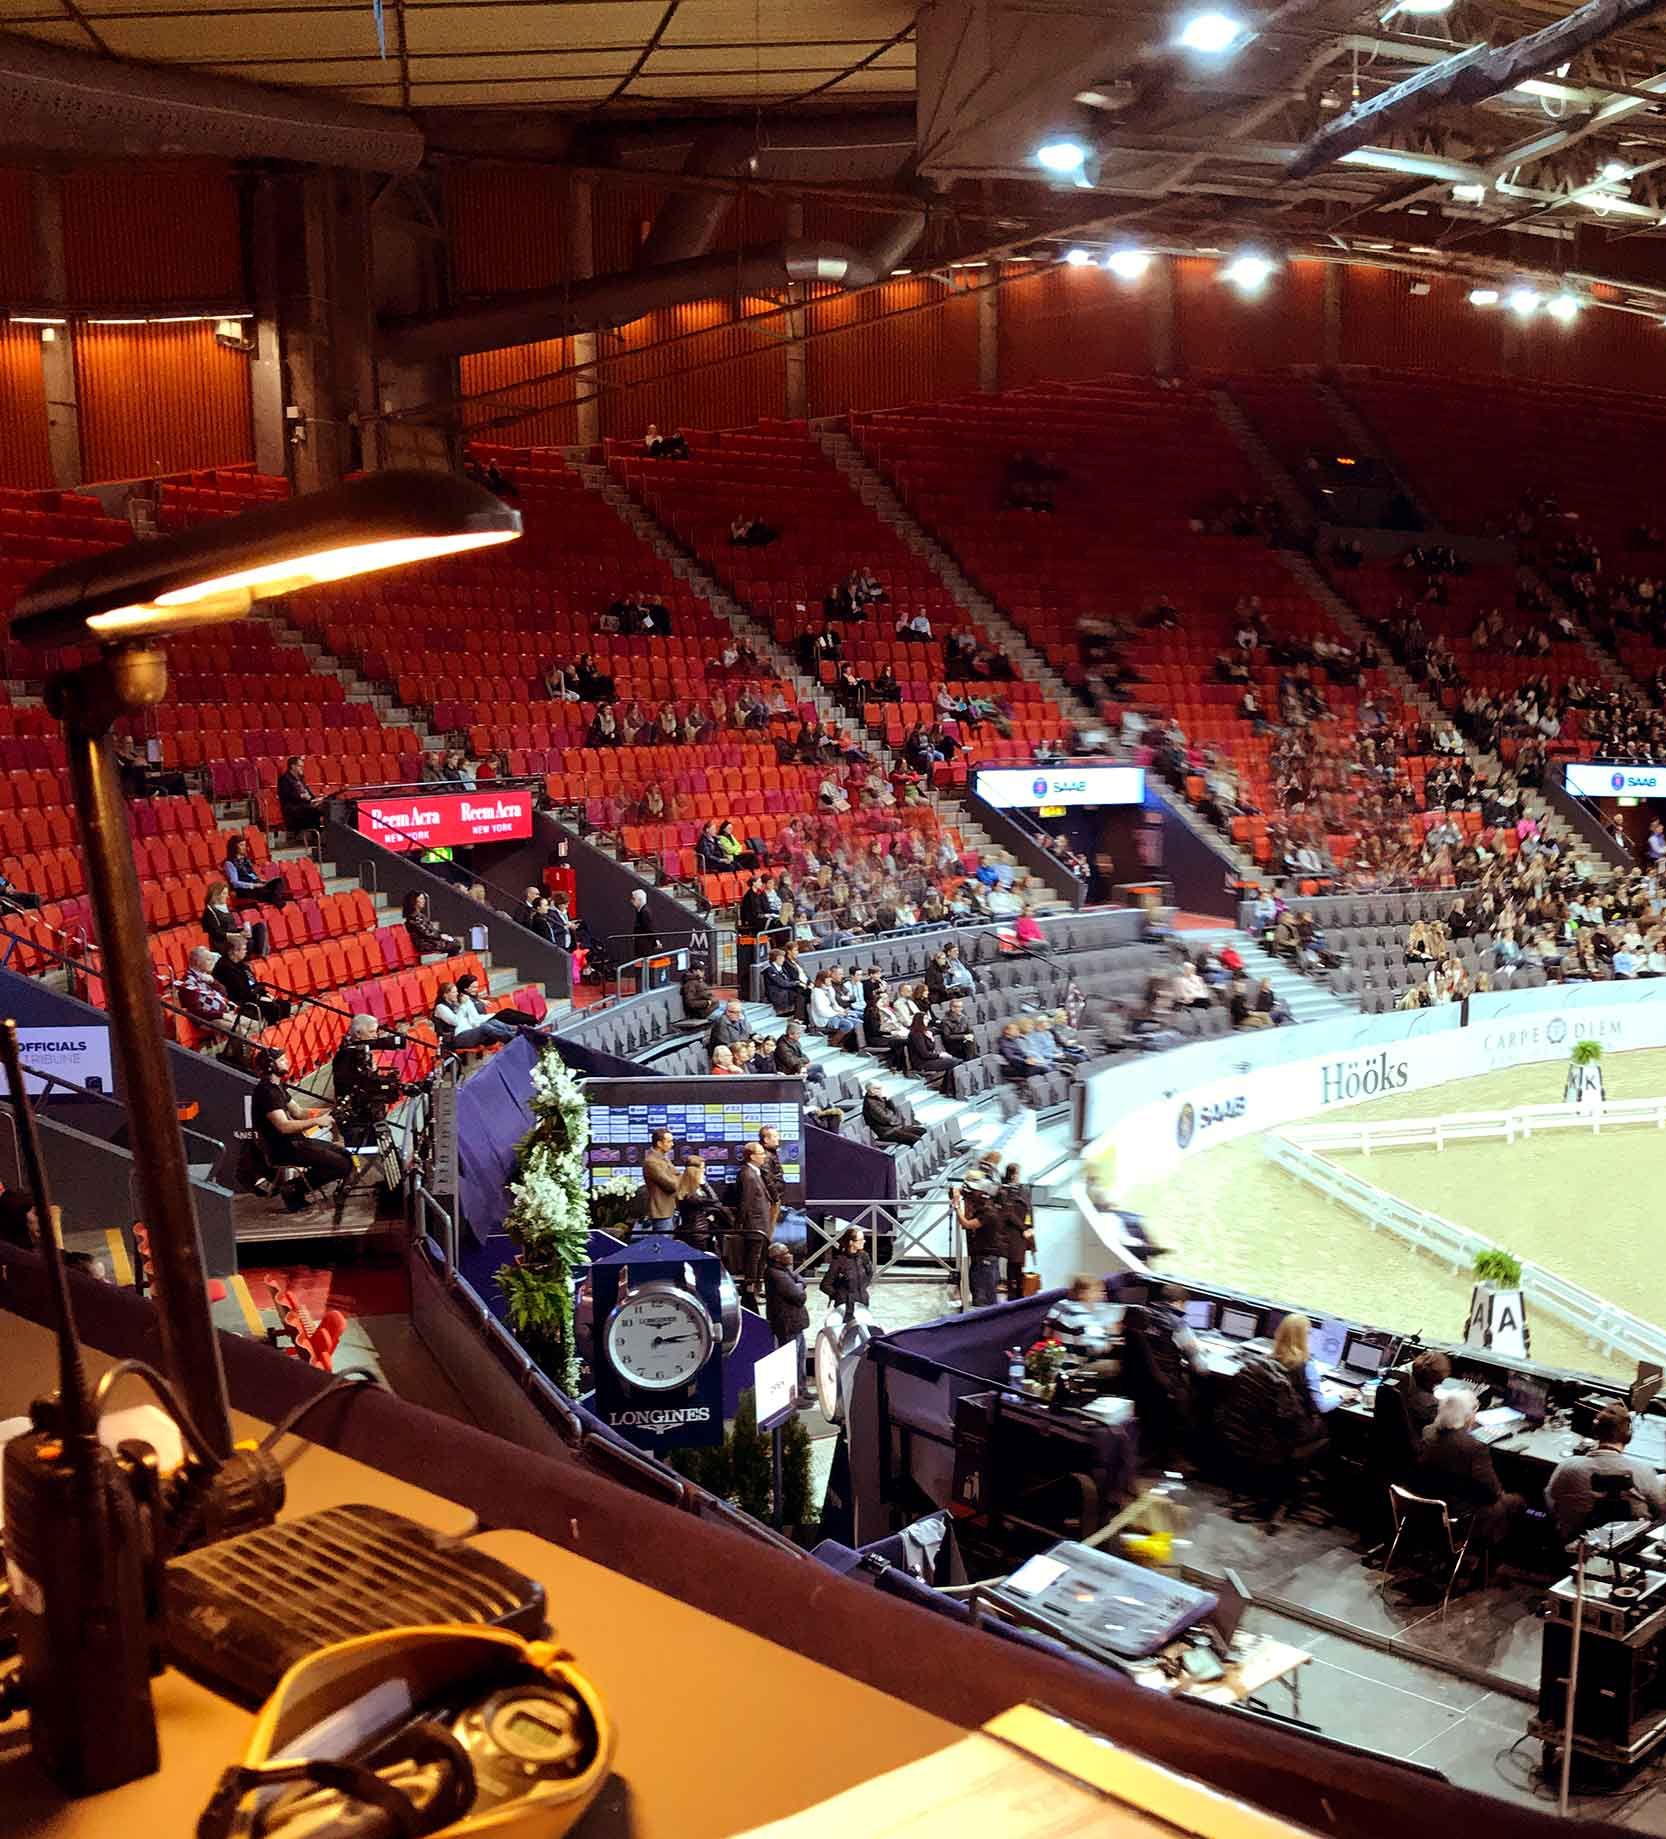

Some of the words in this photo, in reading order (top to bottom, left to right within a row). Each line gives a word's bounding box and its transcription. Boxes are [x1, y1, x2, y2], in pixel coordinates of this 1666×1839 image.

[1628, 777, 1657, 787] SAAB
[472, 824, 490, 834] NEW
[493, 822, 513, 833] YORK
[18, 1041, 87, 1052] OFFICIALS
[1319, 1051, 1409, 1105] Hööks
[1584, 1072, 1598, 1091] K
[621, 1319, 633, 1327] 10
[639, 1316, 677, 1325] LONGINES
[1473, 1303, 1484, 1330] A
[1498, 1306, 1517, 1333] A
[609, 1408, 711, 1426] LONGINES
